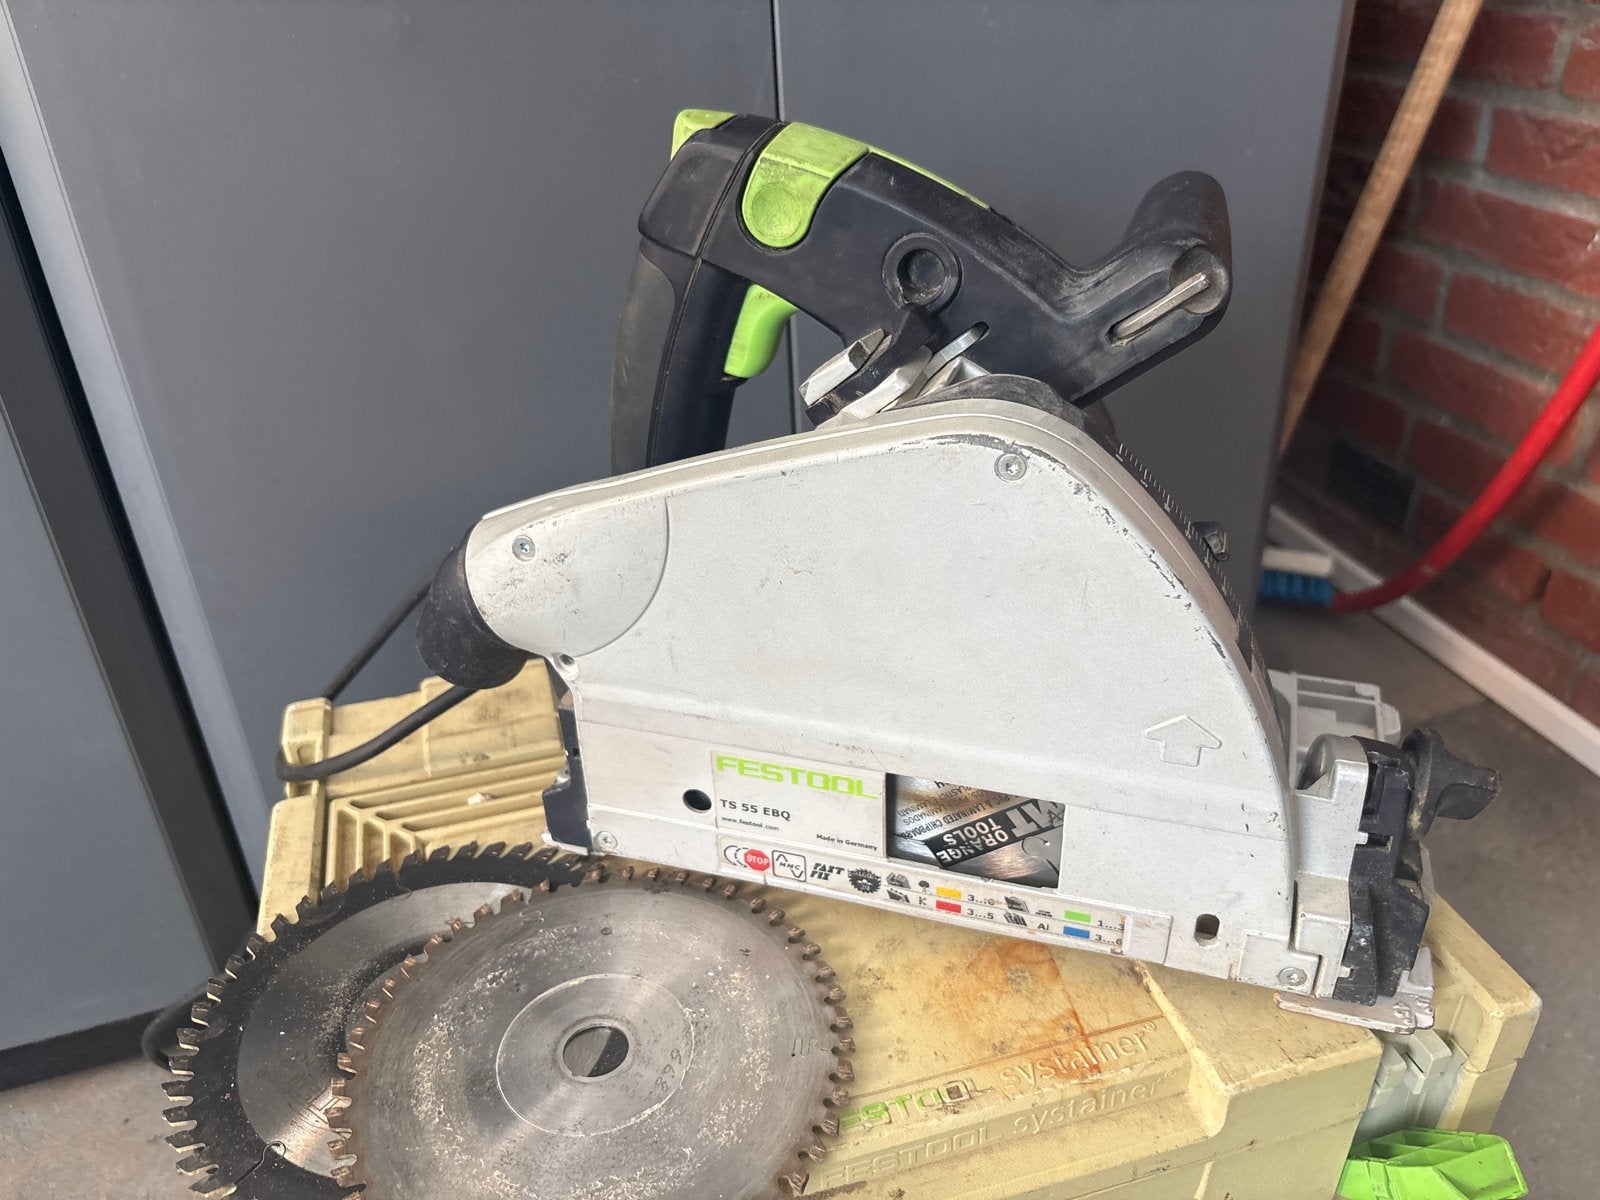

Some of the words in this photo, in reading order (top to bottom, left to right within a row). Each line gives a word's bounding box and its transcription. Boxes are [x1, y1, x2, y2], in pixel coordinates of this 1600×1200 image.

[715, 754, 878, 800] FESTOOL
[719, 798, 737, 810] TS
[741, 802, 759, 814] 55
[763, 806, 791, 822] EBQ
[942, 803, 985, 824] LAMINATED
[1005, 799, 1063, 838] MT
[721, 816, 780, 831] www.festool.com
[943, 817, 1002, 847] TOOLS
[816, 833, 836, 843] Made
[845, 839, 878, 852] Germany
[935, 829, 1009, 863] ORANGE
[746, 854, 770, 866] STOP
[779, 861, 801, 871] MMC
[812, 862, 845, 875] FAST
[810, 870, 831, 881] FIX
[918, 896, 927, 906] K
[967, 908, 994, 920] 3...5
[839, 1077, 996, 1132] ESTOOL
[819, 1126, 1004, 1190] FESTOOL
